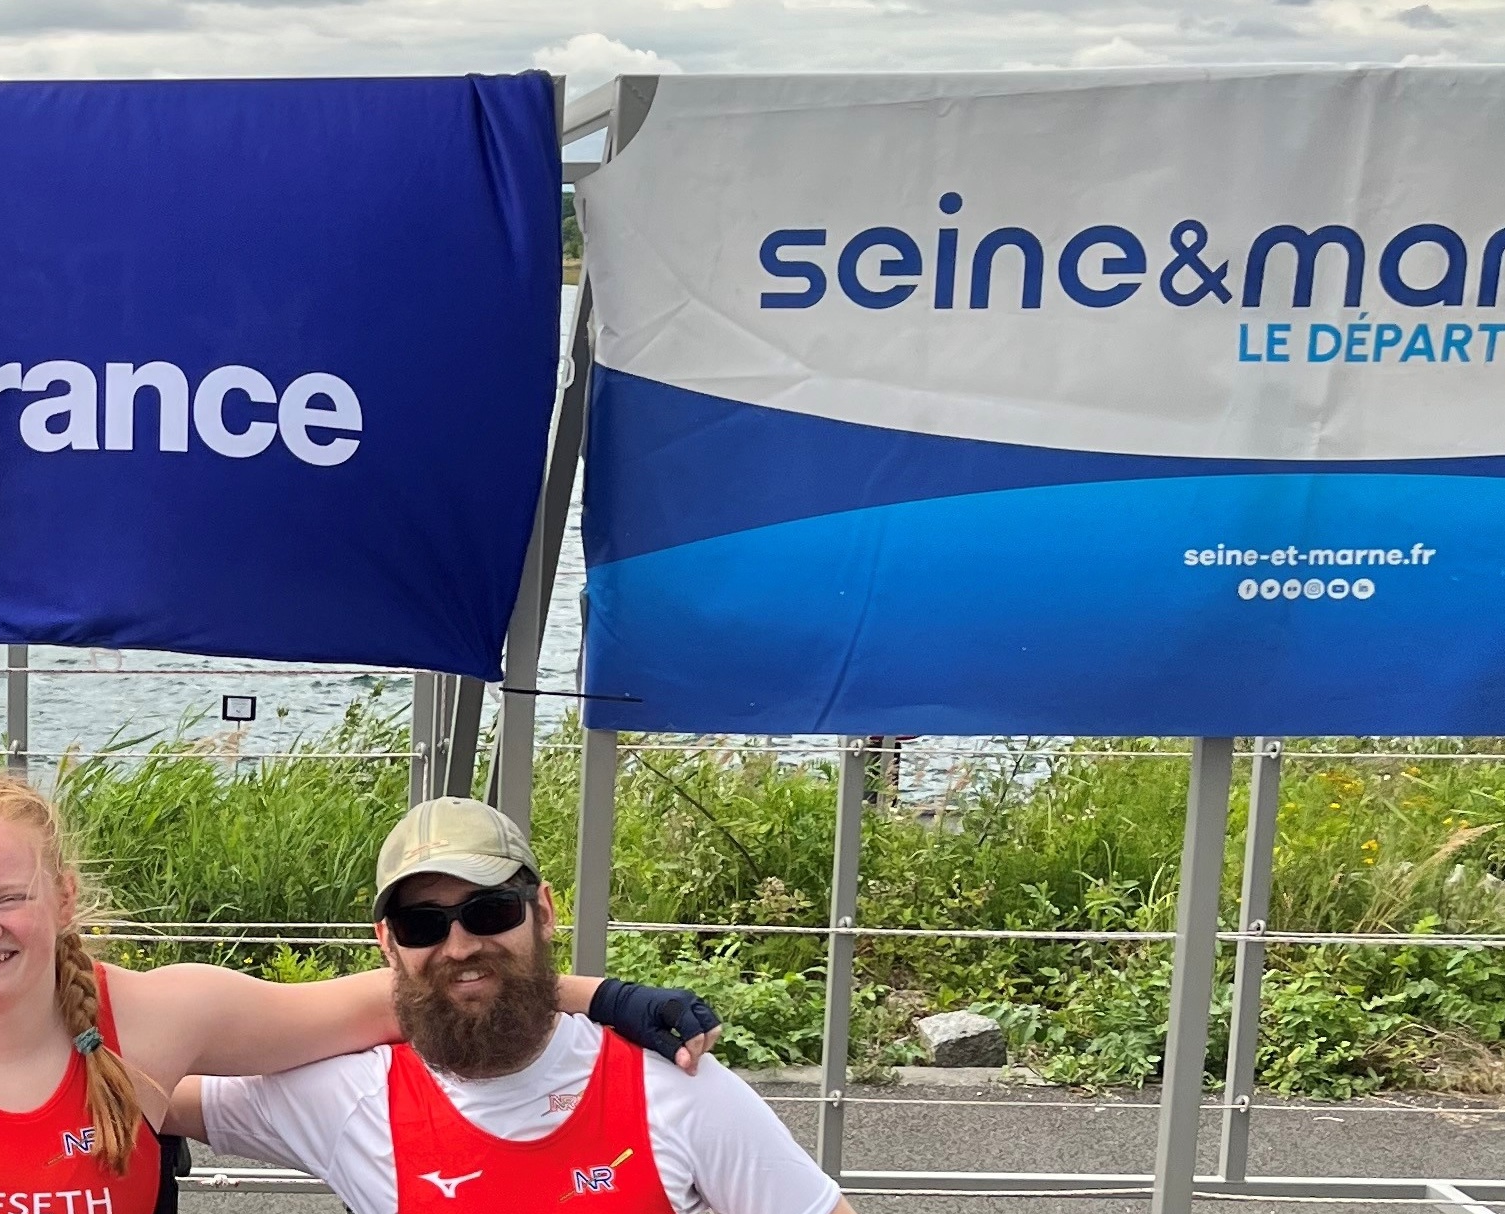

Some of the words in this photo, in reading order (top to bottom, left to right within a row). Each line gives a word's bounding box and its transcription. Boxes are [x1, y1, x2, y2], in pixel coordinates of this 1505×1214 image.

[1239, 323, 1292, 362] LE
[1184, 543, 1437, 566] seine-et-marne.fr
[573, 1165, 615, 1194] NR
